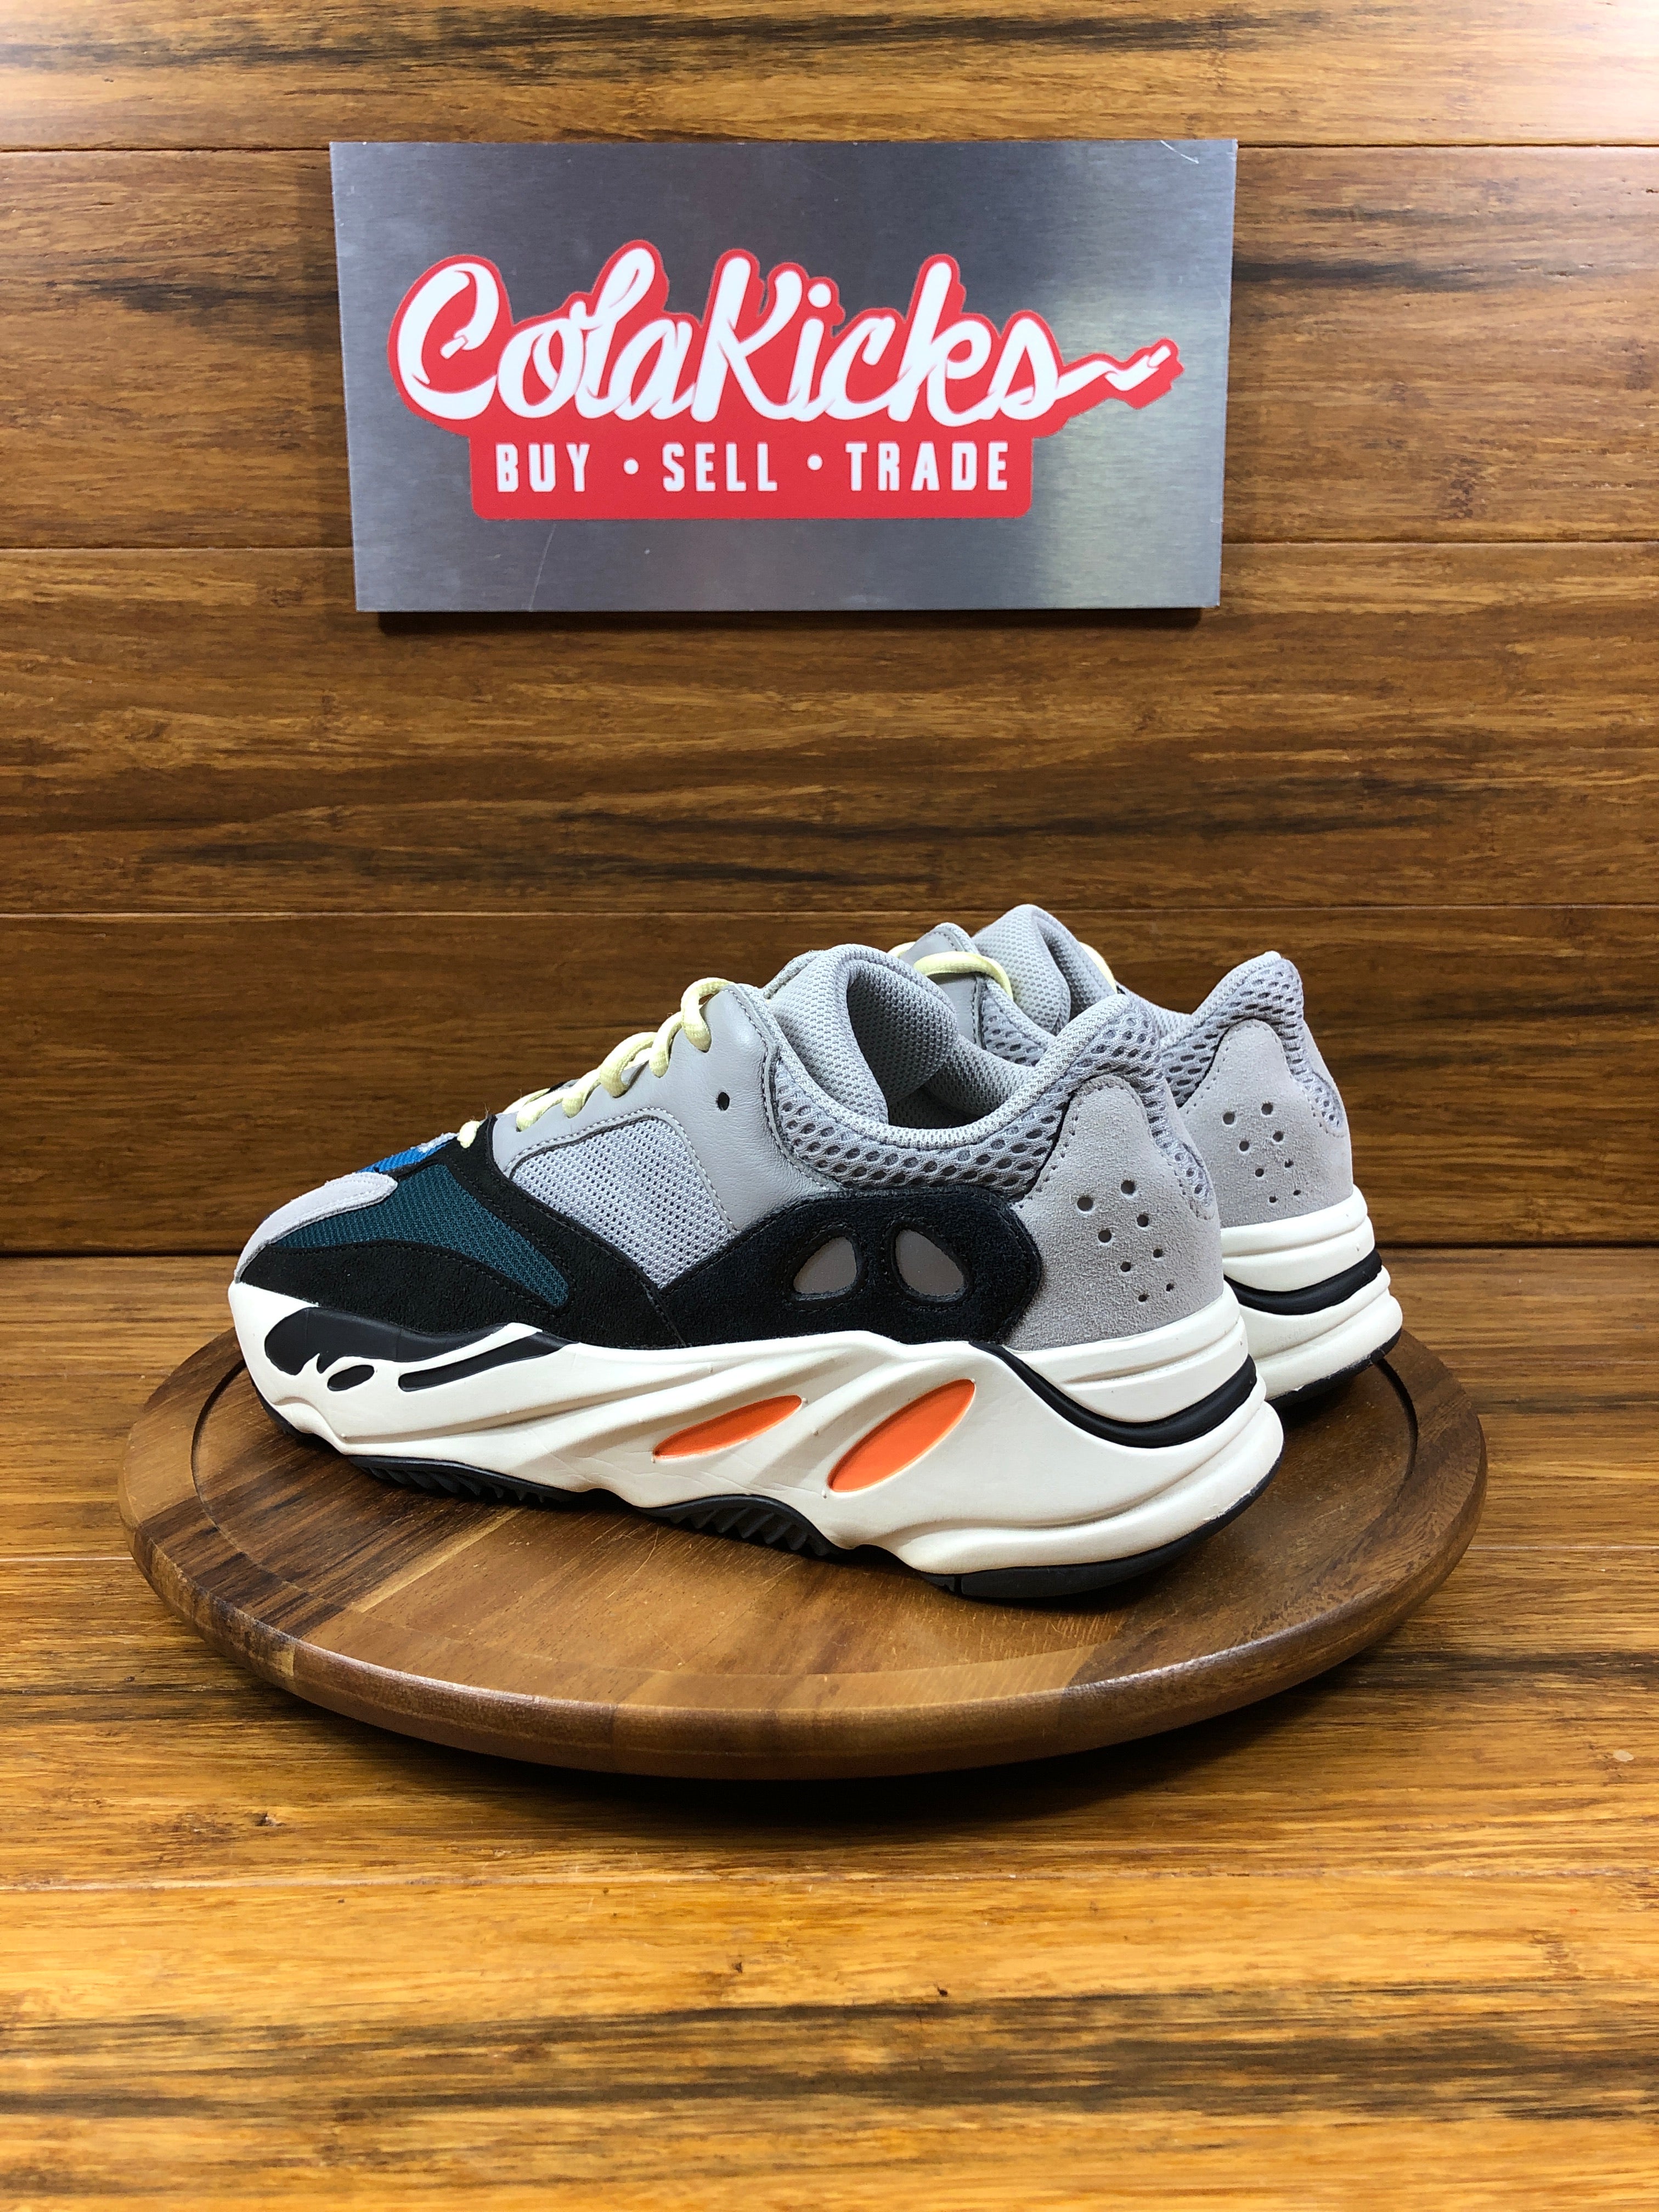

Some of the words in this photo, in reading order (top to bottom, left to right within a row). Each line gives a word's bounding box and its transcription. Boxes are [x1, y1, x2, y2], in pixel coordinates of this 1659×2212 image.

[496, 443, 589, 492] BUY
[663, 443, 778, 492] SELL
[845, 442, 1009, 491] TRADE
